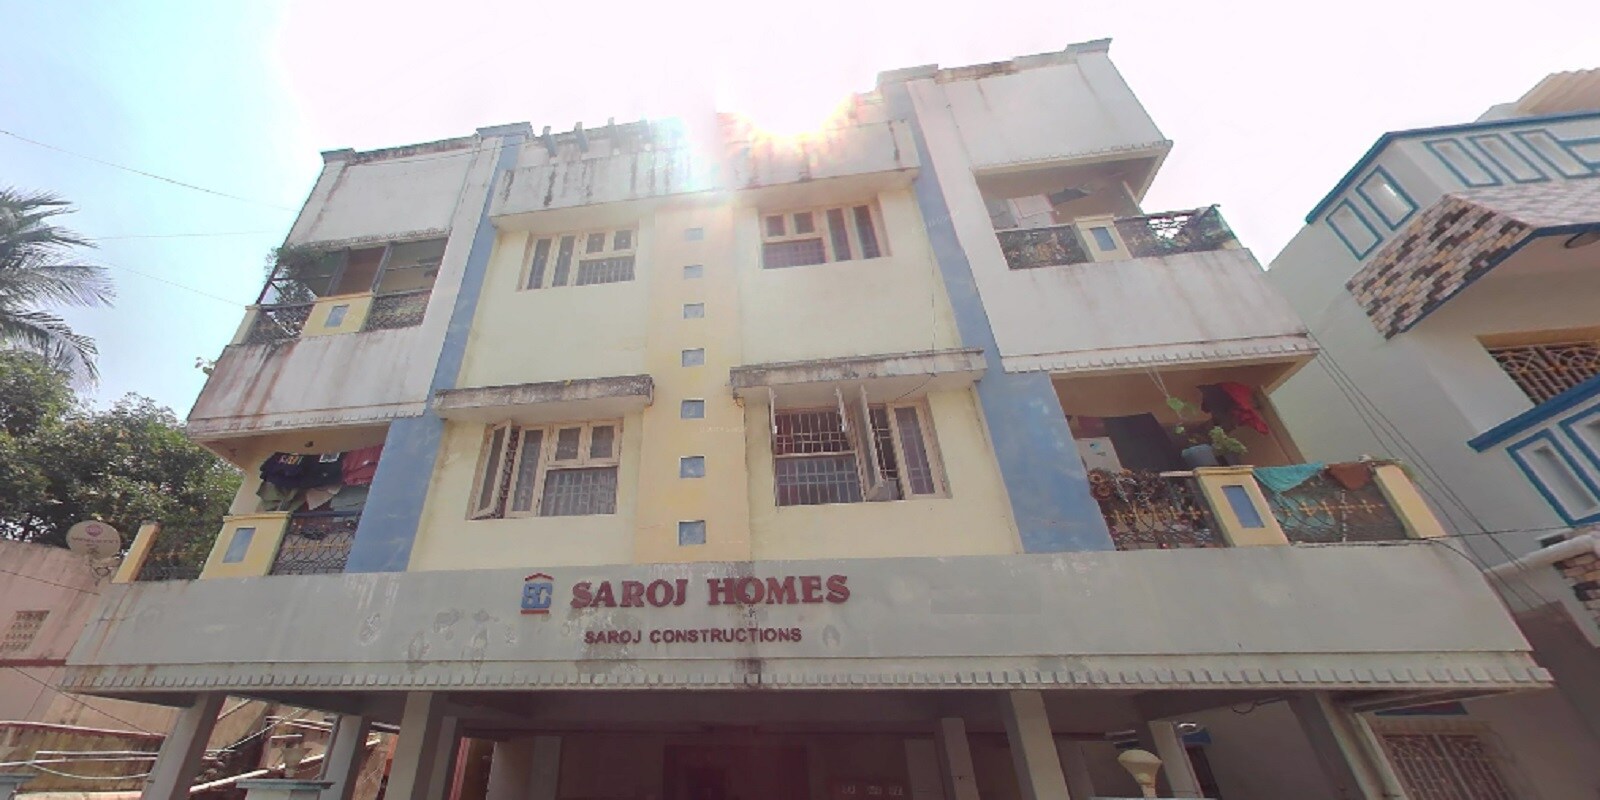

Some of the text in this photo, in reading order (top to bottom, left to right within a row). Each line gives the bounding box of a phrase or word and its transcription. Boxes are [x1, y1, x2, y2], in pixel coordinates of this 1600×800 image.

[570, 575, 850, 609] SAROJ HOMES
[584, 627, 803, 645] SAROJ CONSTRUCTIONS
